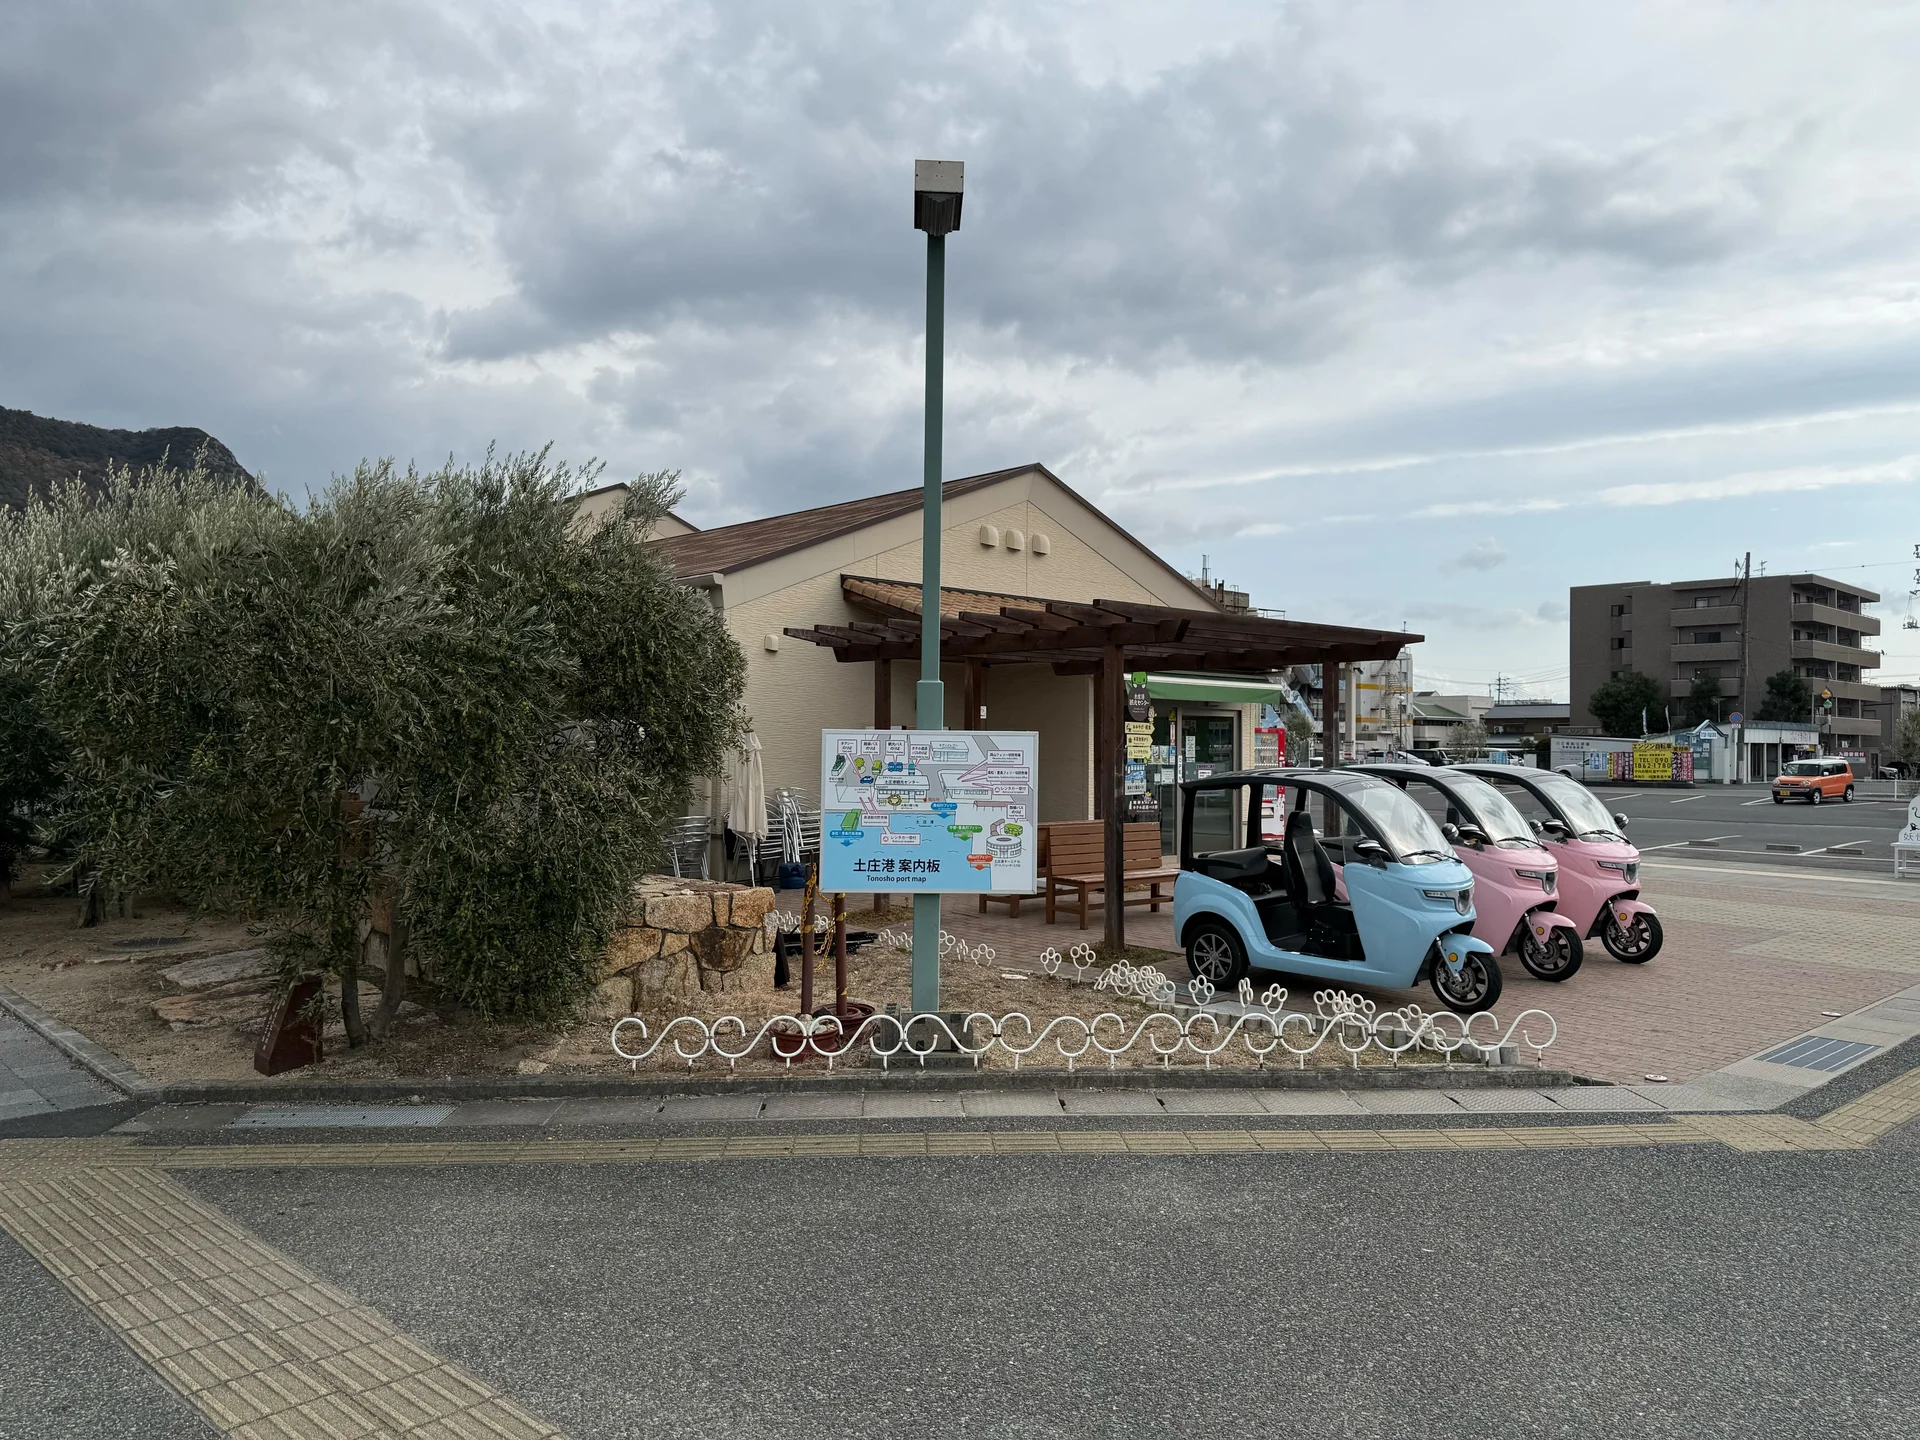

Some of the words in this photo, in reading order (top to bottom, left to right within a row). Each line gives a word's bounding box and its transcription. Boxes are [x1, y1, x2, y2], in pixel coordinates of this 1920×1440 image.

[853, 858, 895, 873] 土庄港
[898, 858, 940, 873] 案内板
